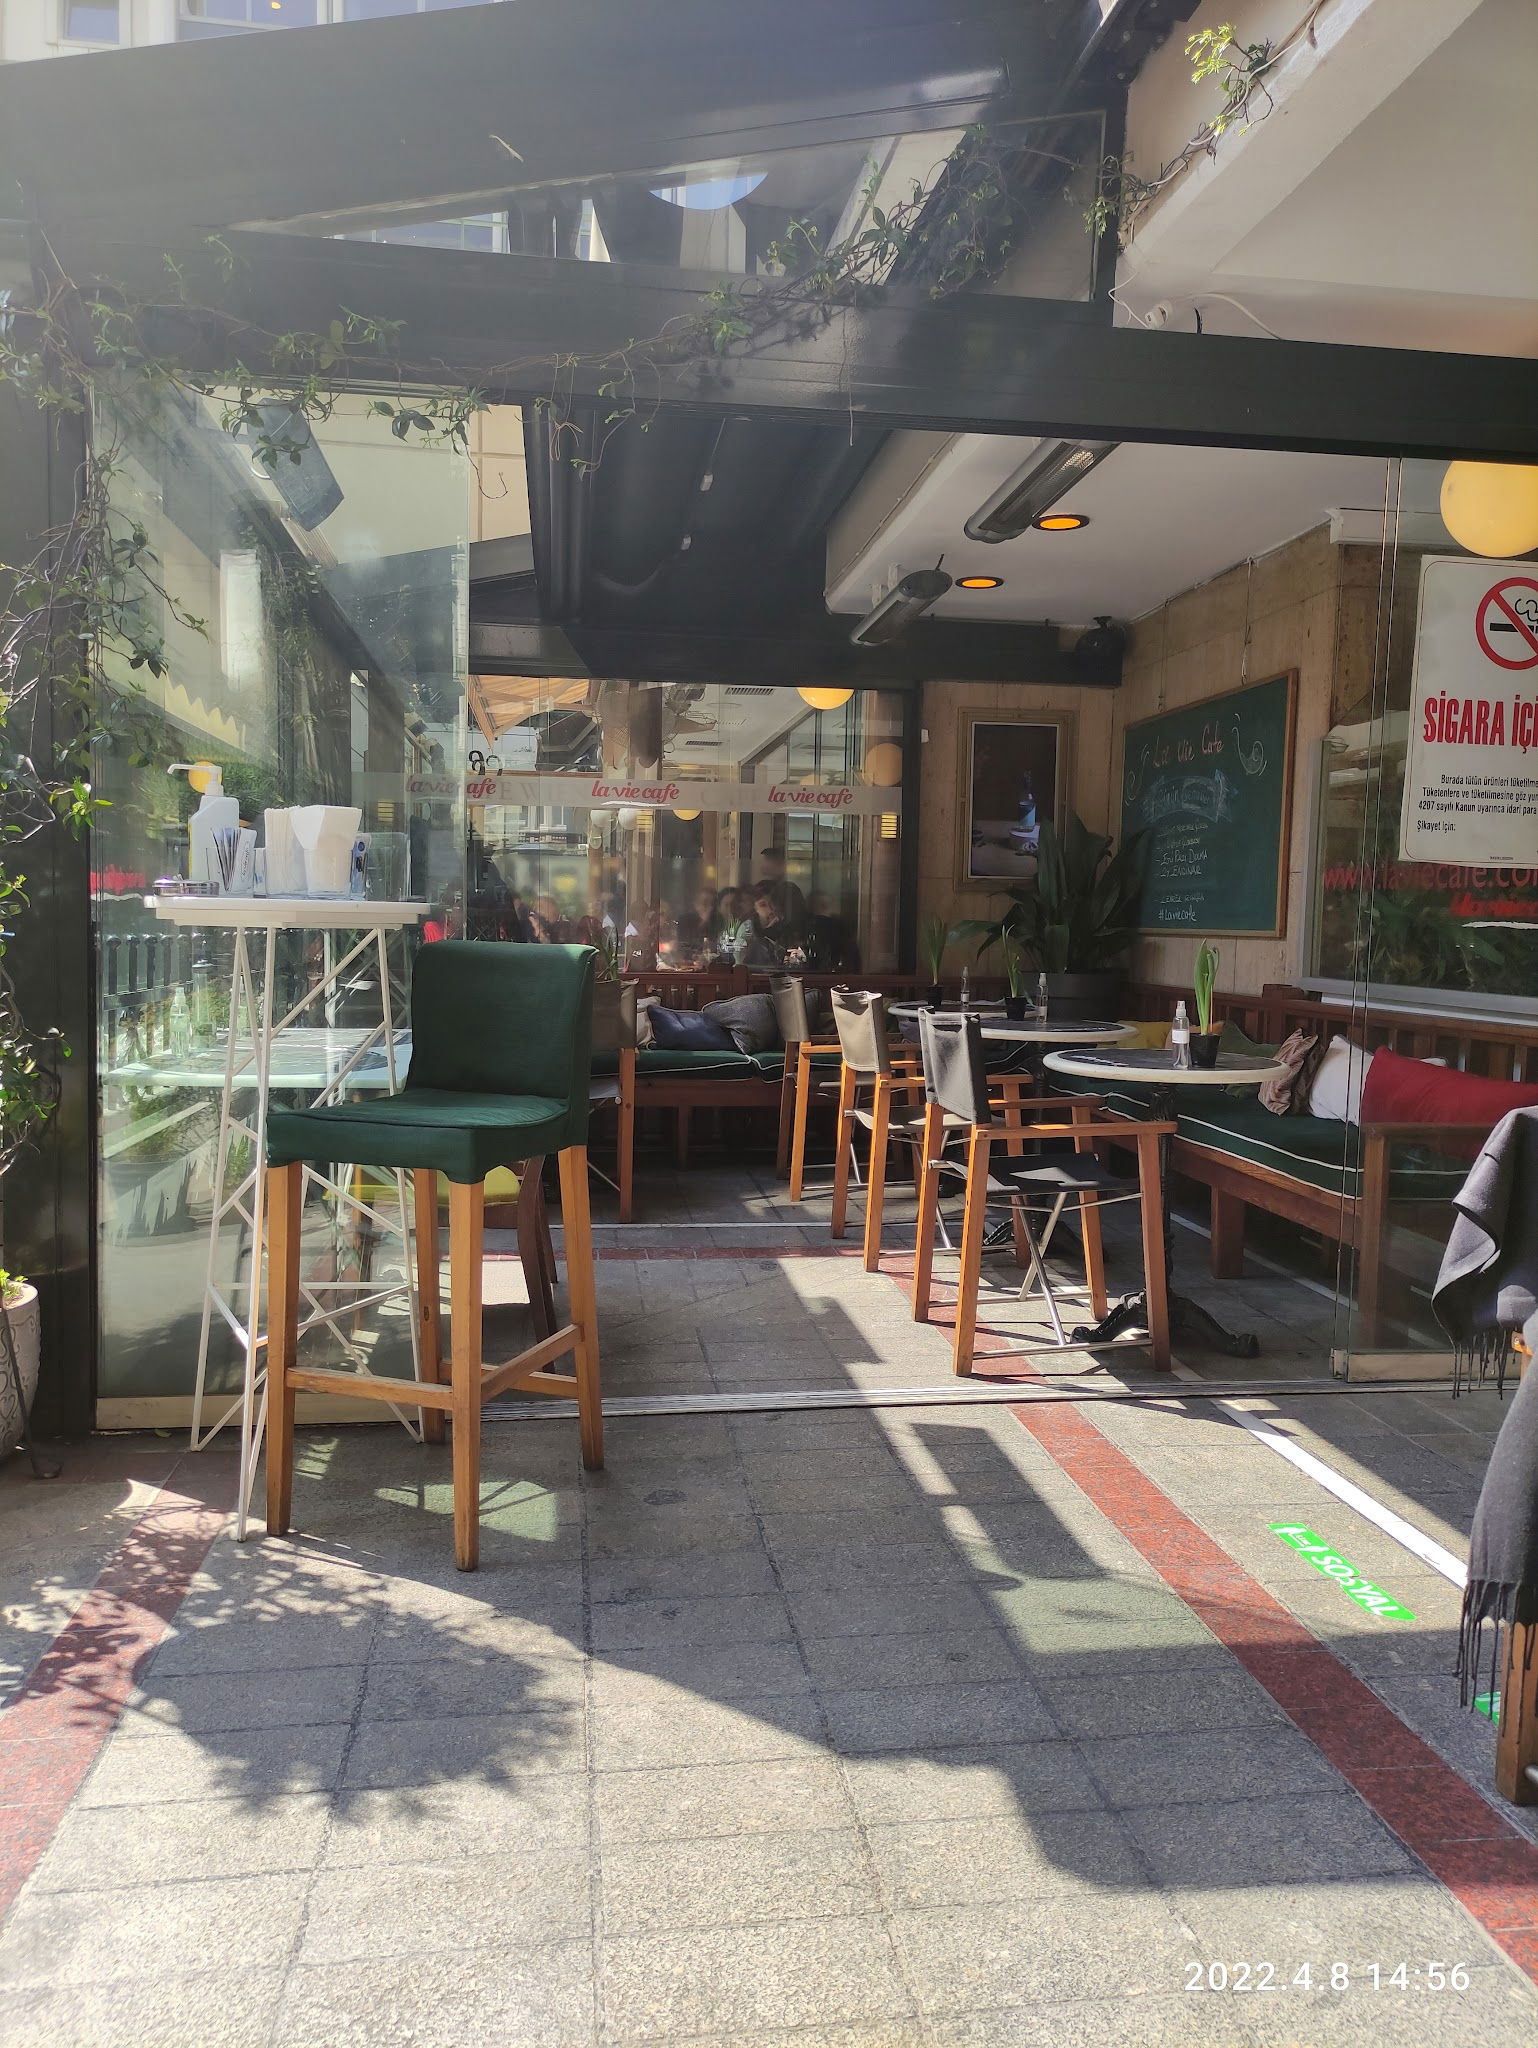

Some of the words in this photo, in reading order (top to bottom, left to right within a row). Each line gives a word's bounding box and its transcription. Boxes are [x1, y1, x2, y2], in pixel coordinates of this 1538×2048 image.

[1423, 690, 1505, 746] SİGARA
[1202, 720, 1225, 753] Cafe
[466, 777, 498, 800] afe
[1441, 774, 1463, 785] Burada
[1466, 775, 1481, 786] tütün
[1484, 775, 1509, 787] ürünleri
[641, 782, 680, 805] cafe
[815, 787, 854, 809] cafe
[1422, 786, 1460, 798] Tüketenlere
[1462, 791, 1469, 799] ve
[1471, 789, 1514, 801] tüketilmesine
[1515, 792, 1526, 803] göz
[1418, 800, 1435, 810] 4207
[1436, 801, 1454, 813] sayılı
[1455, 801, 1476, 812] Kanun
[1477, 804, 1505, 815] uyarınca
[1506, 803, 1521, 814] idari
[1522, 806, 1537, 816] para
[1416, 820, 1441, 833] Şikayet
